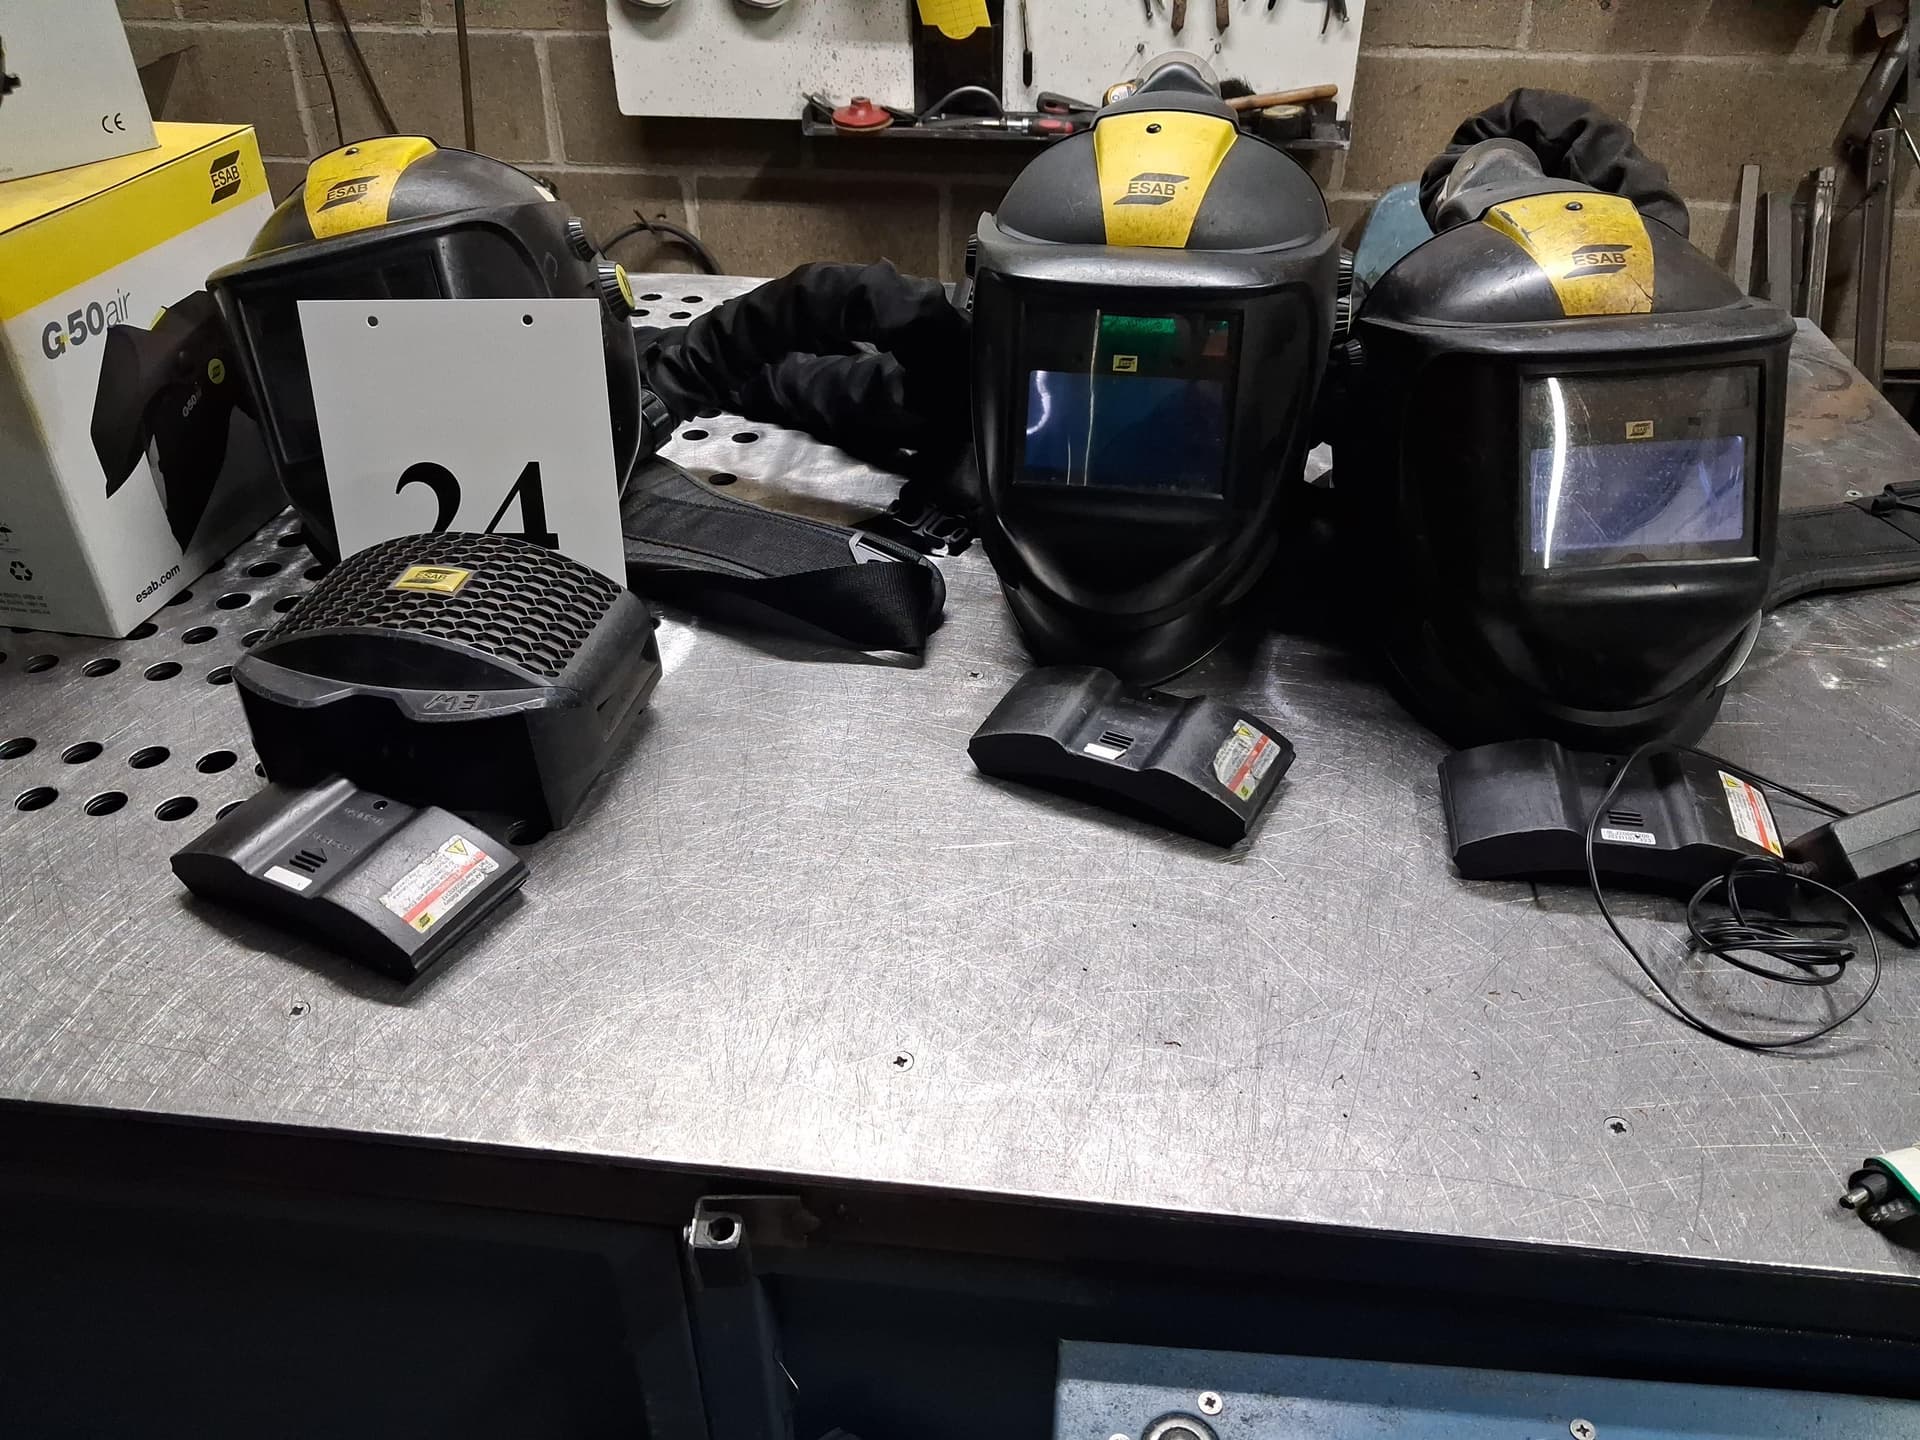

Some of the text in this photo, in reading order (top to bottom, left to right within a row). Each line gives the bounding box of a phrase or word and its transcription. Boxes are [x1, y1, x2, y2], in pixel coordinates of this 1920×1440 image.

[210, 164, 241, 189] ESAB
[326, 183, 369, 201] ESAB
[1127, 182, 1177, 196] ESAB
[1572, 252, 1627, 266] ESAB
[395, 461, 560, 550] 24
[135, 564, 181, 603] esab.com
